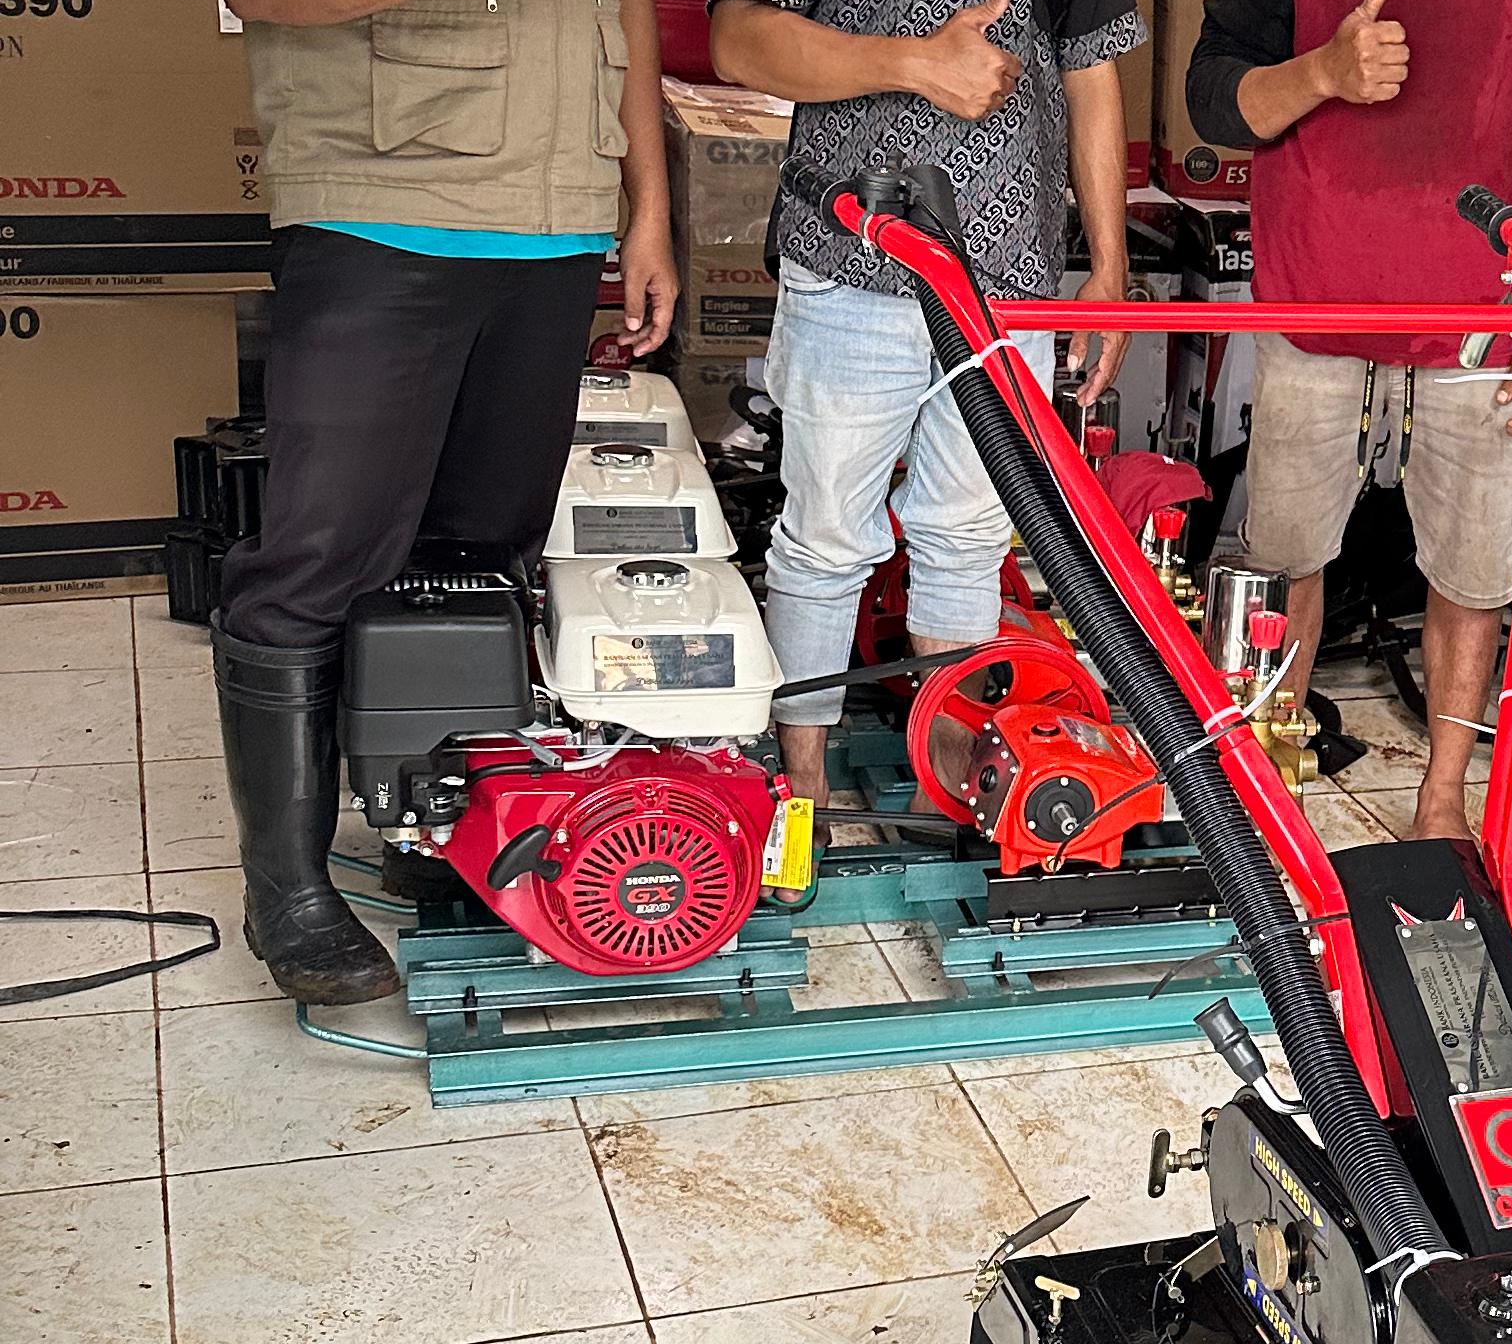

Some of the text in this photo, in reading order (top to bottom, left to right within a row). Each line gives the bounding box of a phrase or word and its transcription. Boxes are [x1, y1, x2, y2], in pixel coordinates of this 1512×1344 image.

[0, 225, 15, 239] e
[1215, 244, 1254, 272] Tas
[704, 300, 751, 313] Engine
[704, 321, 752, 334] Moteur
[625, 874, 681, 886] HONDA
[626, 885, 679, 904] GX
[1437, 958, 1463, 1007] PRASARANA
[1418, 965, 1450, 1031] BANK INDONESIA
[1255, 1136, 1312, 1218] HIGH SPEED
[1261, 1294, 1291, 1344] SPEED
